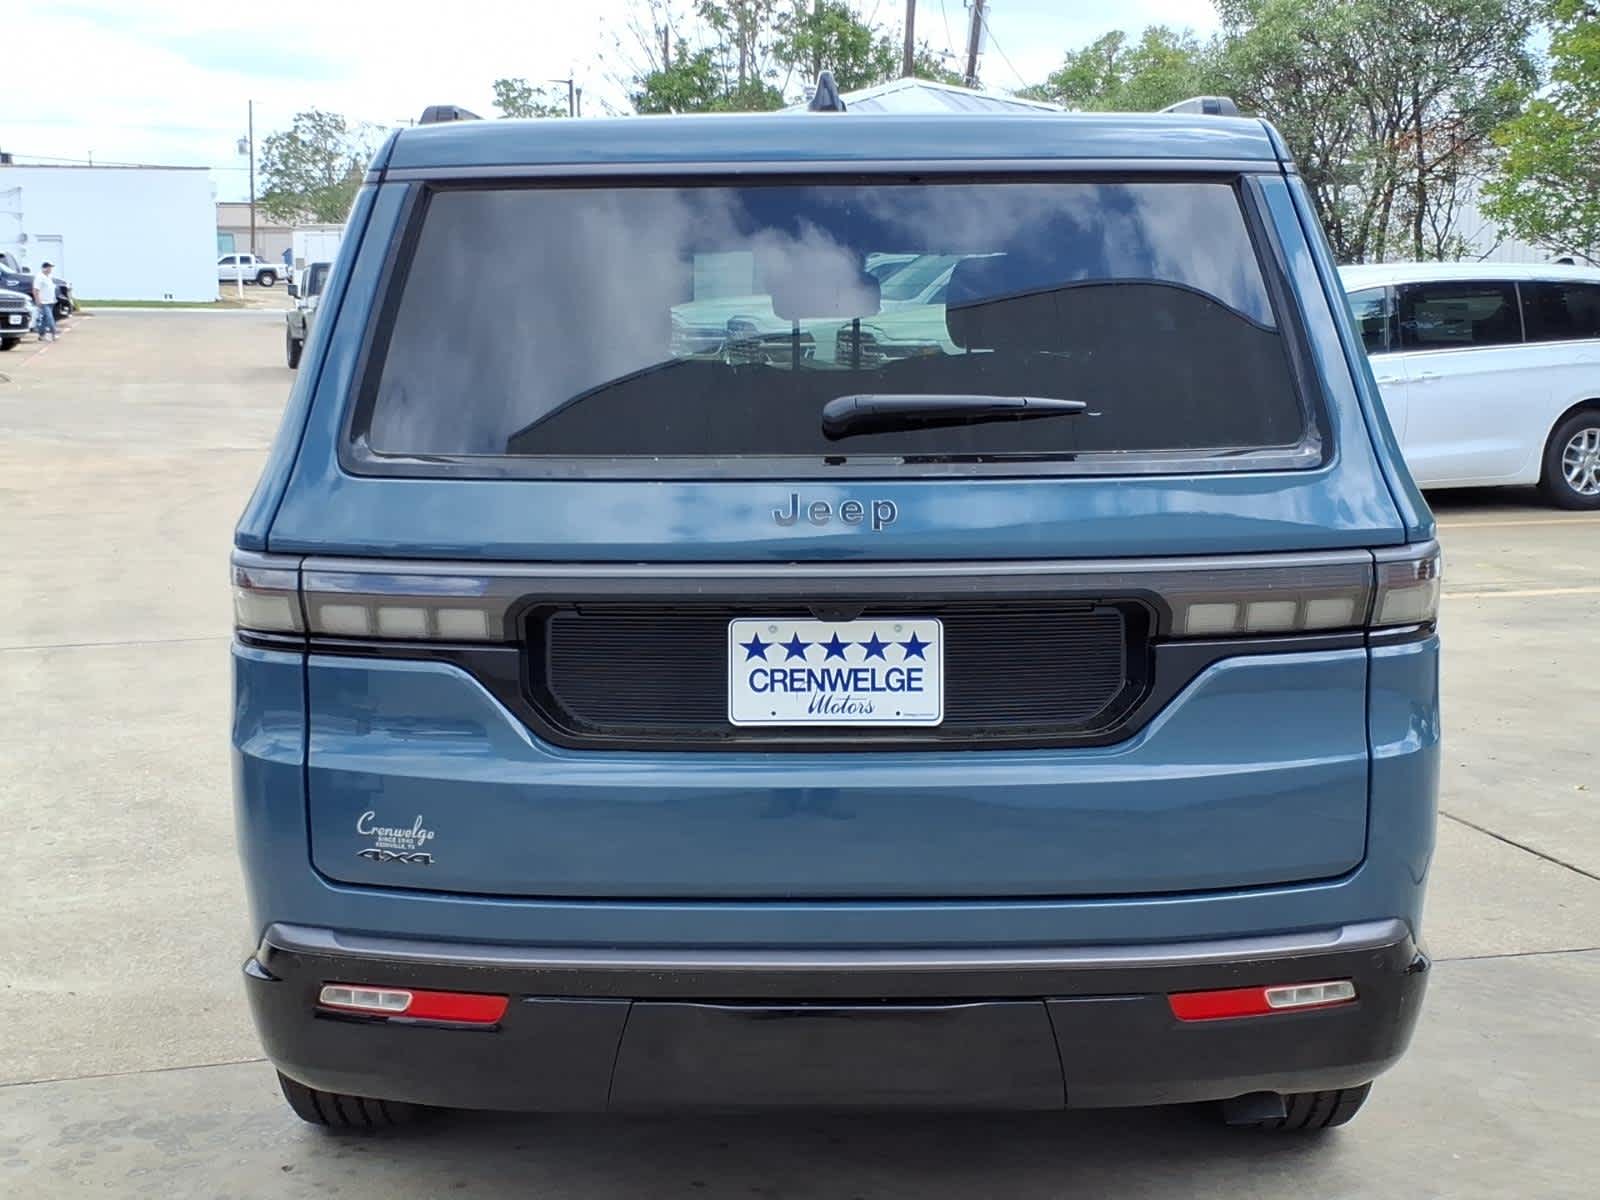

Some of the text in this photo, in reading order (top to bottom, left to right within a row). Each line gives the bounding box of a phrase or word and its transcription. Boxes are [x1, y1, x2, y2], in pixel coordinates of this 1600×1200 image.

[772, 493, 898, 531] Jeep
[749, 667, 923, 692] CRENWELGE
[808, 692, 875, 714] Motors
[357, 811, 434, 846] Crenwelge
